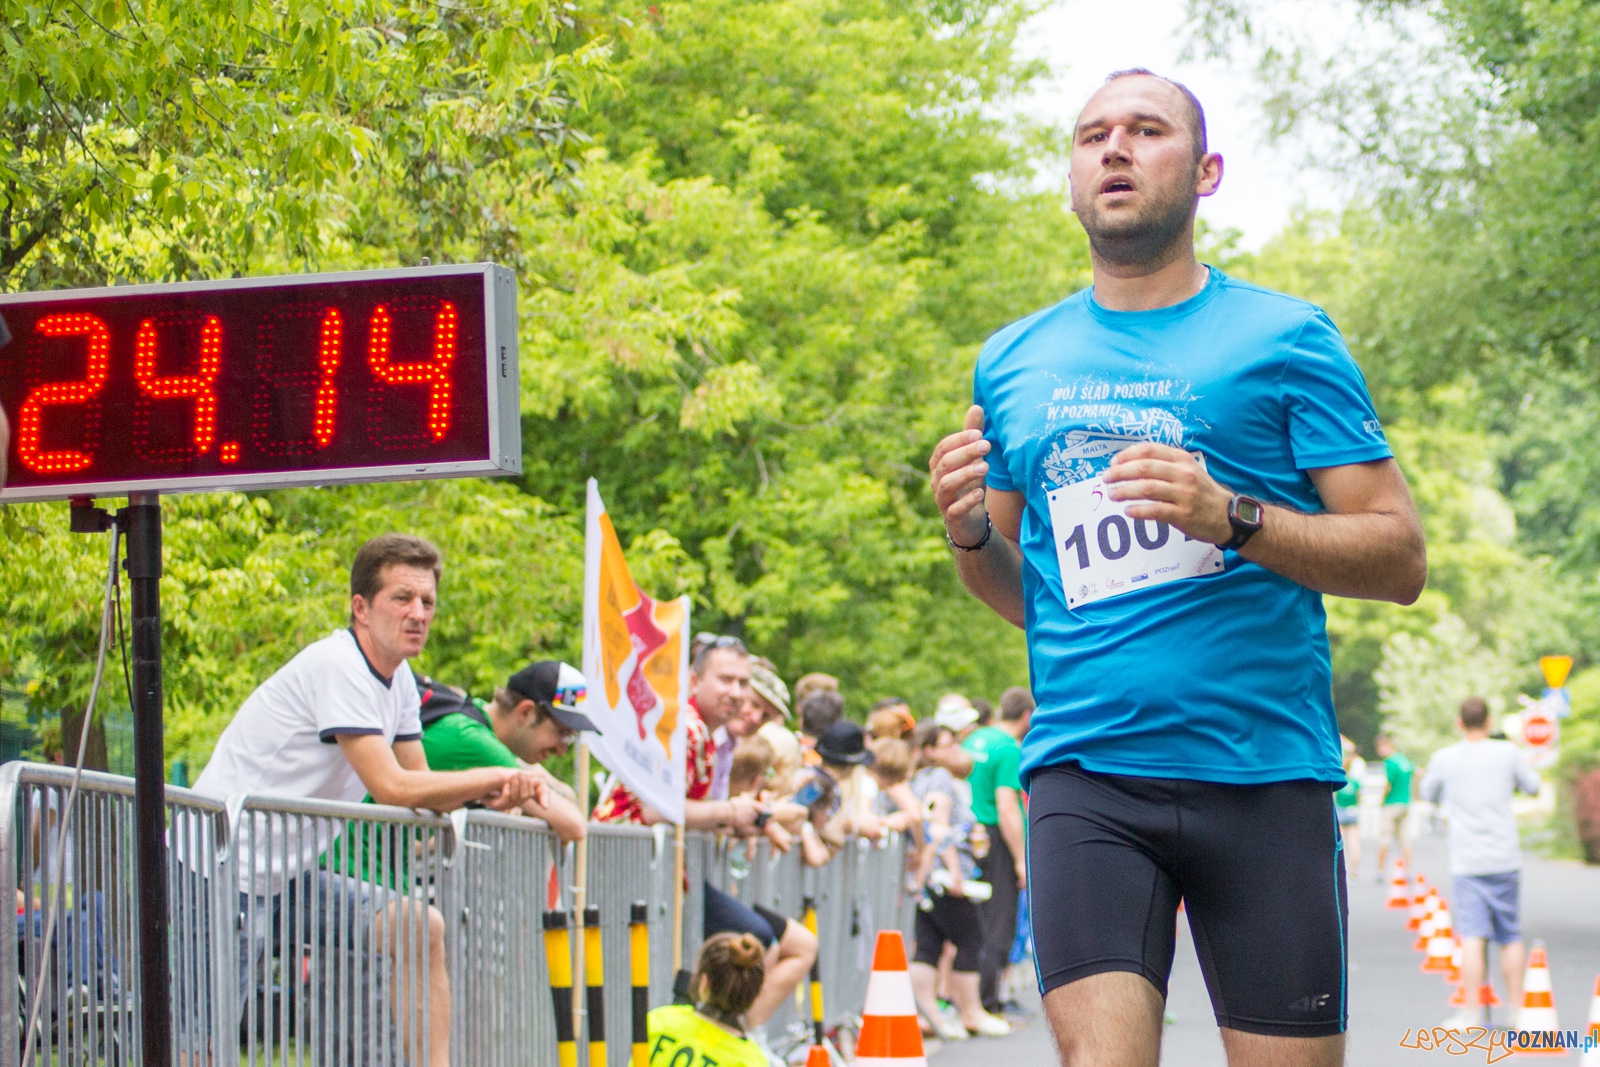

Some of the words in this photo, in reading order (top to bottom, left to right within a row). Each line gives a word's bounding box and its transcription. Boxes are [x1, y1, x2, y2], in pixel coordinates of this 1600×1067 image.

[18, 302, 457, 473] 24.14
[1114, 380, 1172, 399] POZOSTAŁ
[1047, 405, 1060, 420] W
[1061, 404, 1122, 419] POZNANIU
[1082, 443, 1108, 455] MALTA
[1091, 484, 1103, 512] 5
[1064, 514, 1197, 570] 100
